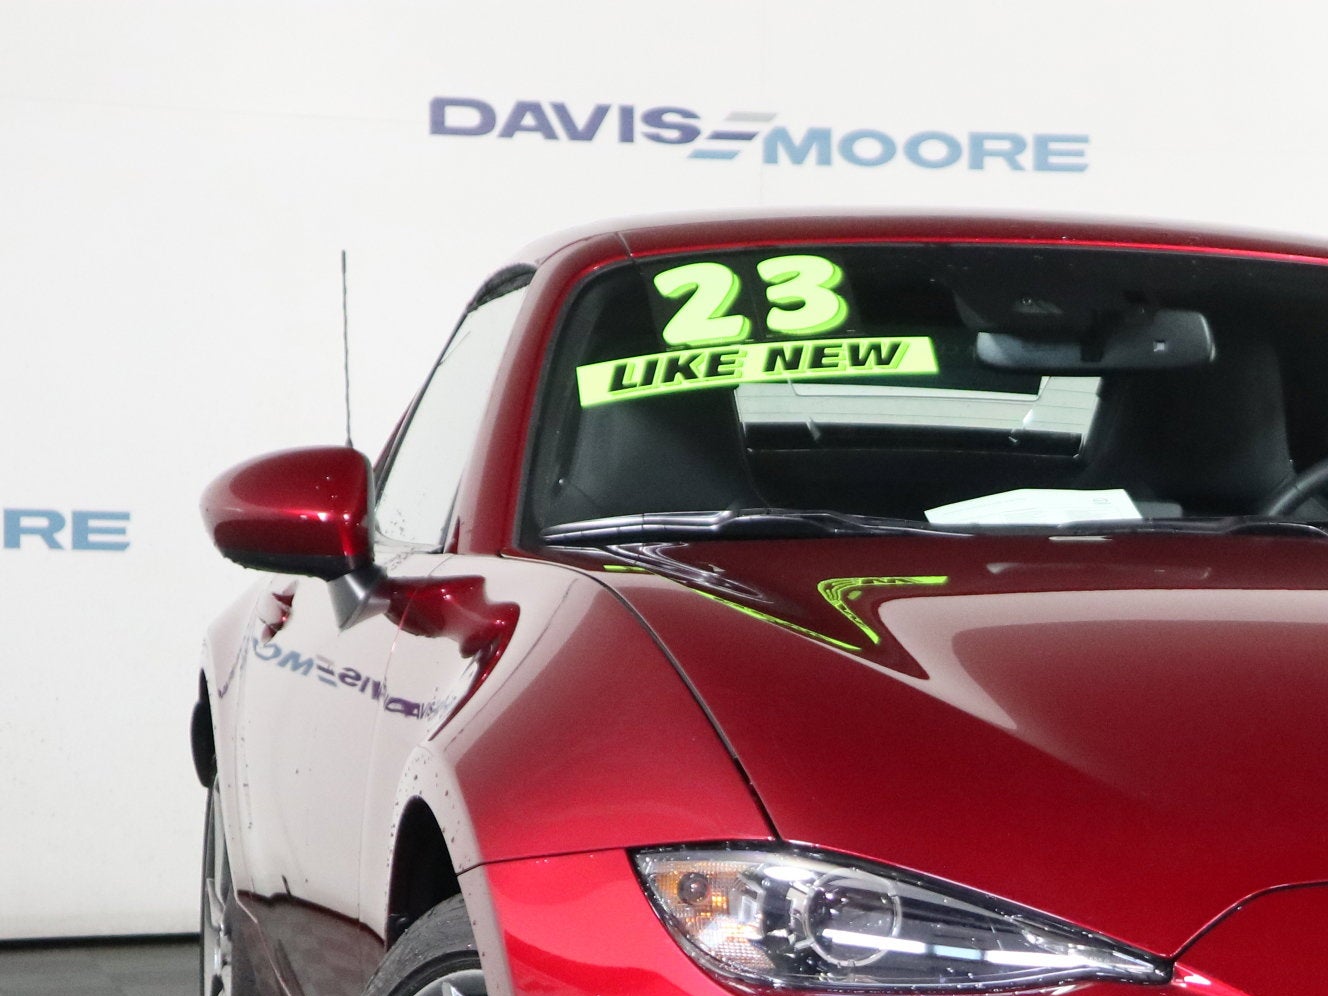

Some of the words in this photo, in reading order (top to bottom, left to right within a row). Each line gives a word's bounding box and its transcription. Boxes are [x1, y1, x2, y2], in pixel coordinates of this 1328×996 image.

[429, 96, 701, 144] DAVIS
[762, 126, 1090, 173] MOORE
[653, 254, 848, 346] 23
[608, 349, 744, 393] LIKE
[763, 341, 905, 374] NEW
[3, 508, 131, 551] RE
